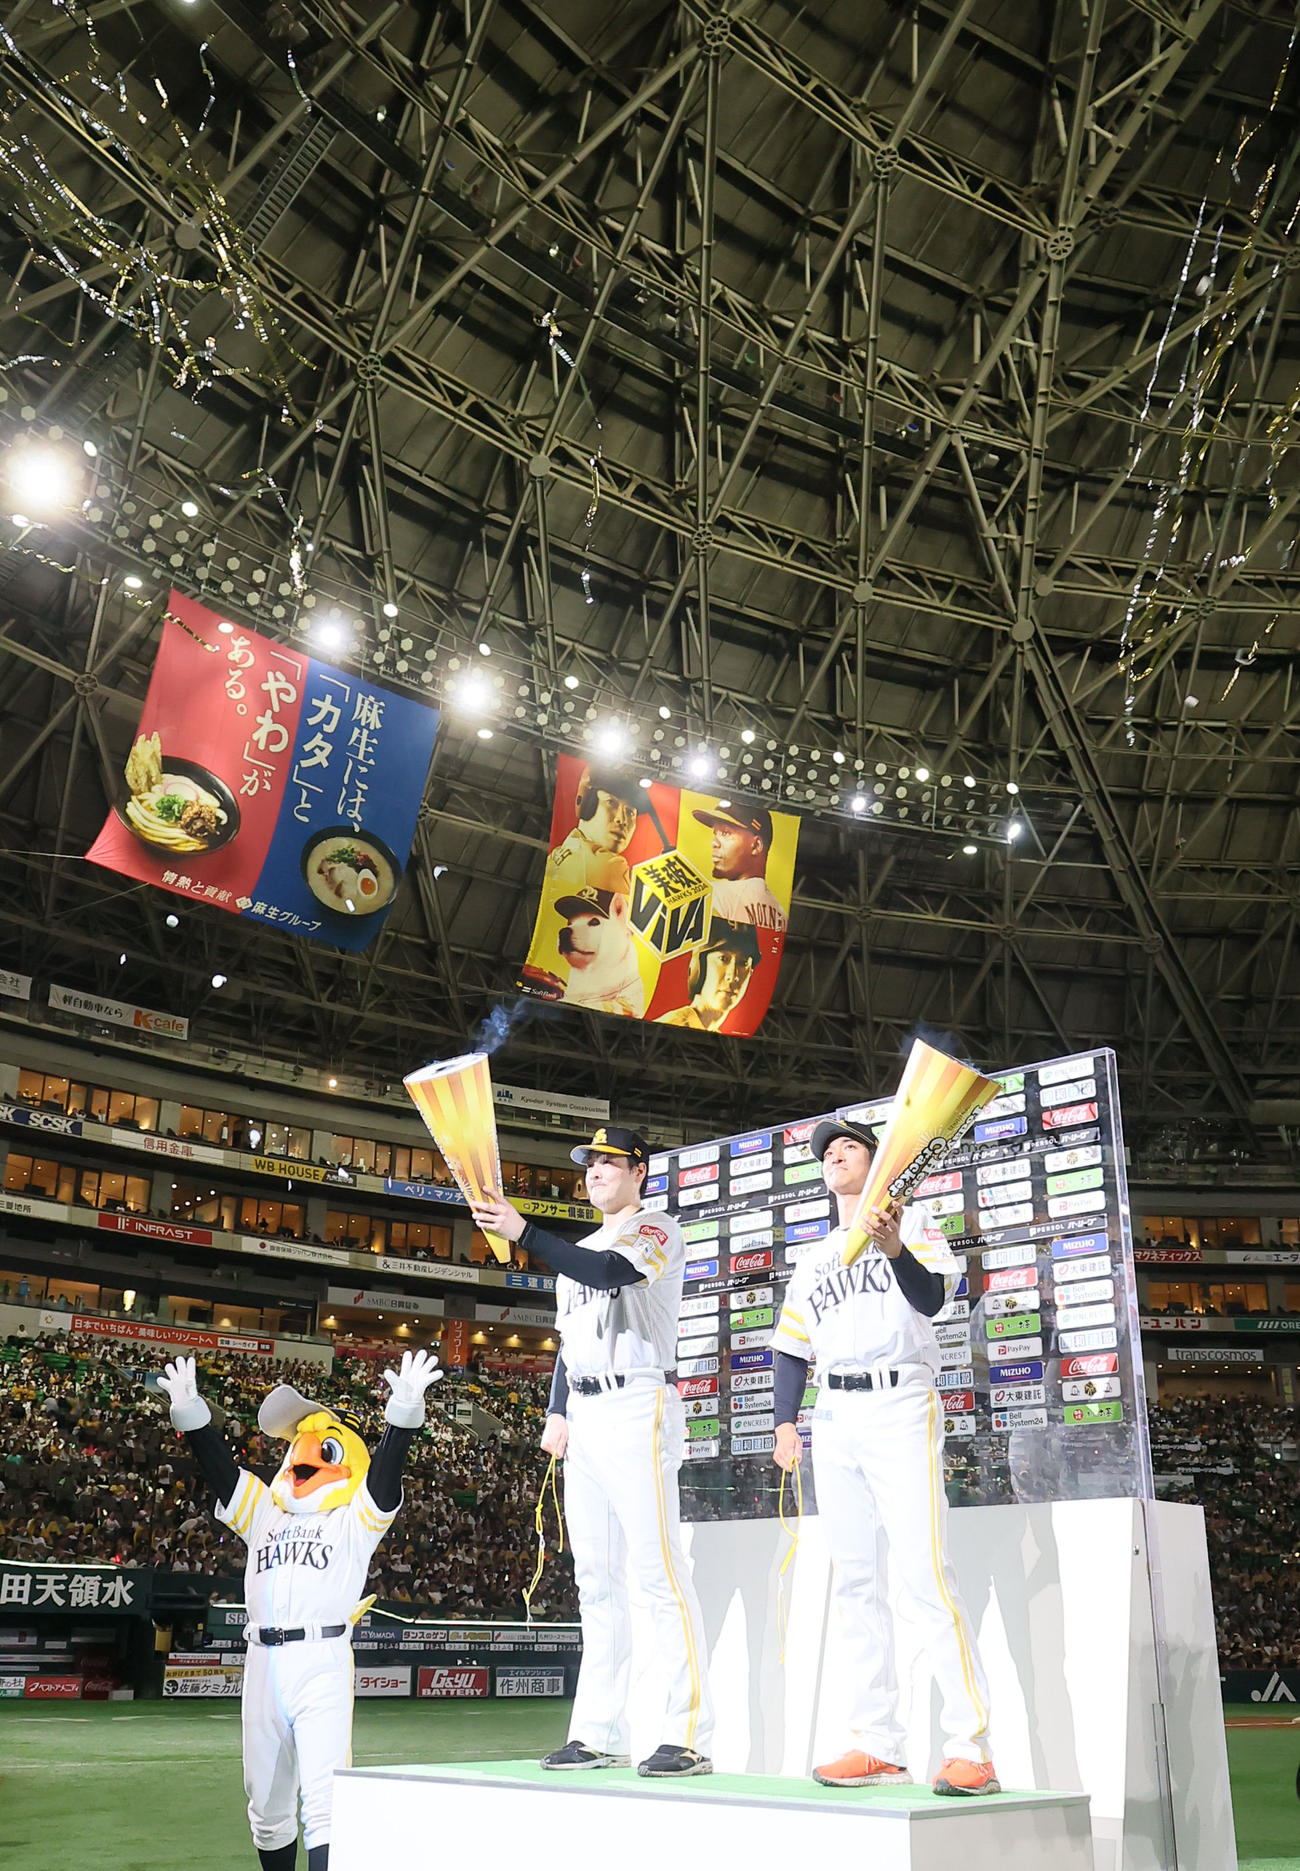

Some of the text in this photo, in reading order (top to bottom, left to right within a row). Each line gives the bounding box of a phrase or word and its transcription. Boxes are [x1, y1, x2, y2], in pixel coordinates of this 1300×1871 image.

[224, 635, 254, 716] ある。
[240, 650, 302, 797] 「やわ」が
[293, 673, 351, 824] 「カタ」と
[337, 691, 386, 833] 麻生には、
[161, 869, 233, 905] 情熱と貢献
[667, 890, 692, 905] HAWKS
[250, 900, 322, 933] 麻生グループ
[61, 993, 124, 1019] 軽自動車なら
[133, 1009, 185, 1034] K-cafe
[28, 1111, 74, 1135] SCSK
[985, 1123, 1015, 1135] MIZUHO
[143, 1136, 193, 1158] 信用金庫
[739, 1139, 763, 1149] MIZUHO
[254, 1158, 275, 1173] WB
[279, 1164, 320, 1180] HOUSE
[888, 1137, 947, 1198] Cracker
[531, 1201, 595, 1220] アンサー倶楽部
[135, 1221, 194, 1241] INFRAST
[794, 1225, 819, 1236] MIZUHO
[1063, 1239, 1095, 1251] MIZUHO
[686, 1265, 709, 1275] MIZUHO
[935, 1331, 967, 1342] System24
[1008, 1345, 1031, 1353] PayPay
[1175, 1348, 1257, 1362] transcosmos
[740, 1354, 764, 1363] MIZUHO
[1000, 1367, 1031, 1377] MIZUHO
[683, 1379, 712, 1394] Coca-Cola
[743, 1374, 771, 1386] 大東建託
[1007, 1389, 1042, 1402] 大東建託
[745, 1400, 772, 1410] System24
[1009, 1418, 1044, 1428] System24
[266, 1524, 324, 1544] SoftBank
[256, 1541, 333, 1575] HAWKS
[0, 1573, 136, 1608] 田天領水
[368, 1630, 396, 1639] YAMADA
[404, 1631, 447, 1640] タンスのゲン
[360, 1676, 408, 1689] ダイショー
[430, 1669, 476, 1689] G&YU
[500, 1678, 561, 1695] 作州商事
[179, 1683, 241, 1695] 佐藤ケミカル
[421, 1687, 484, 1697] BATTERY
